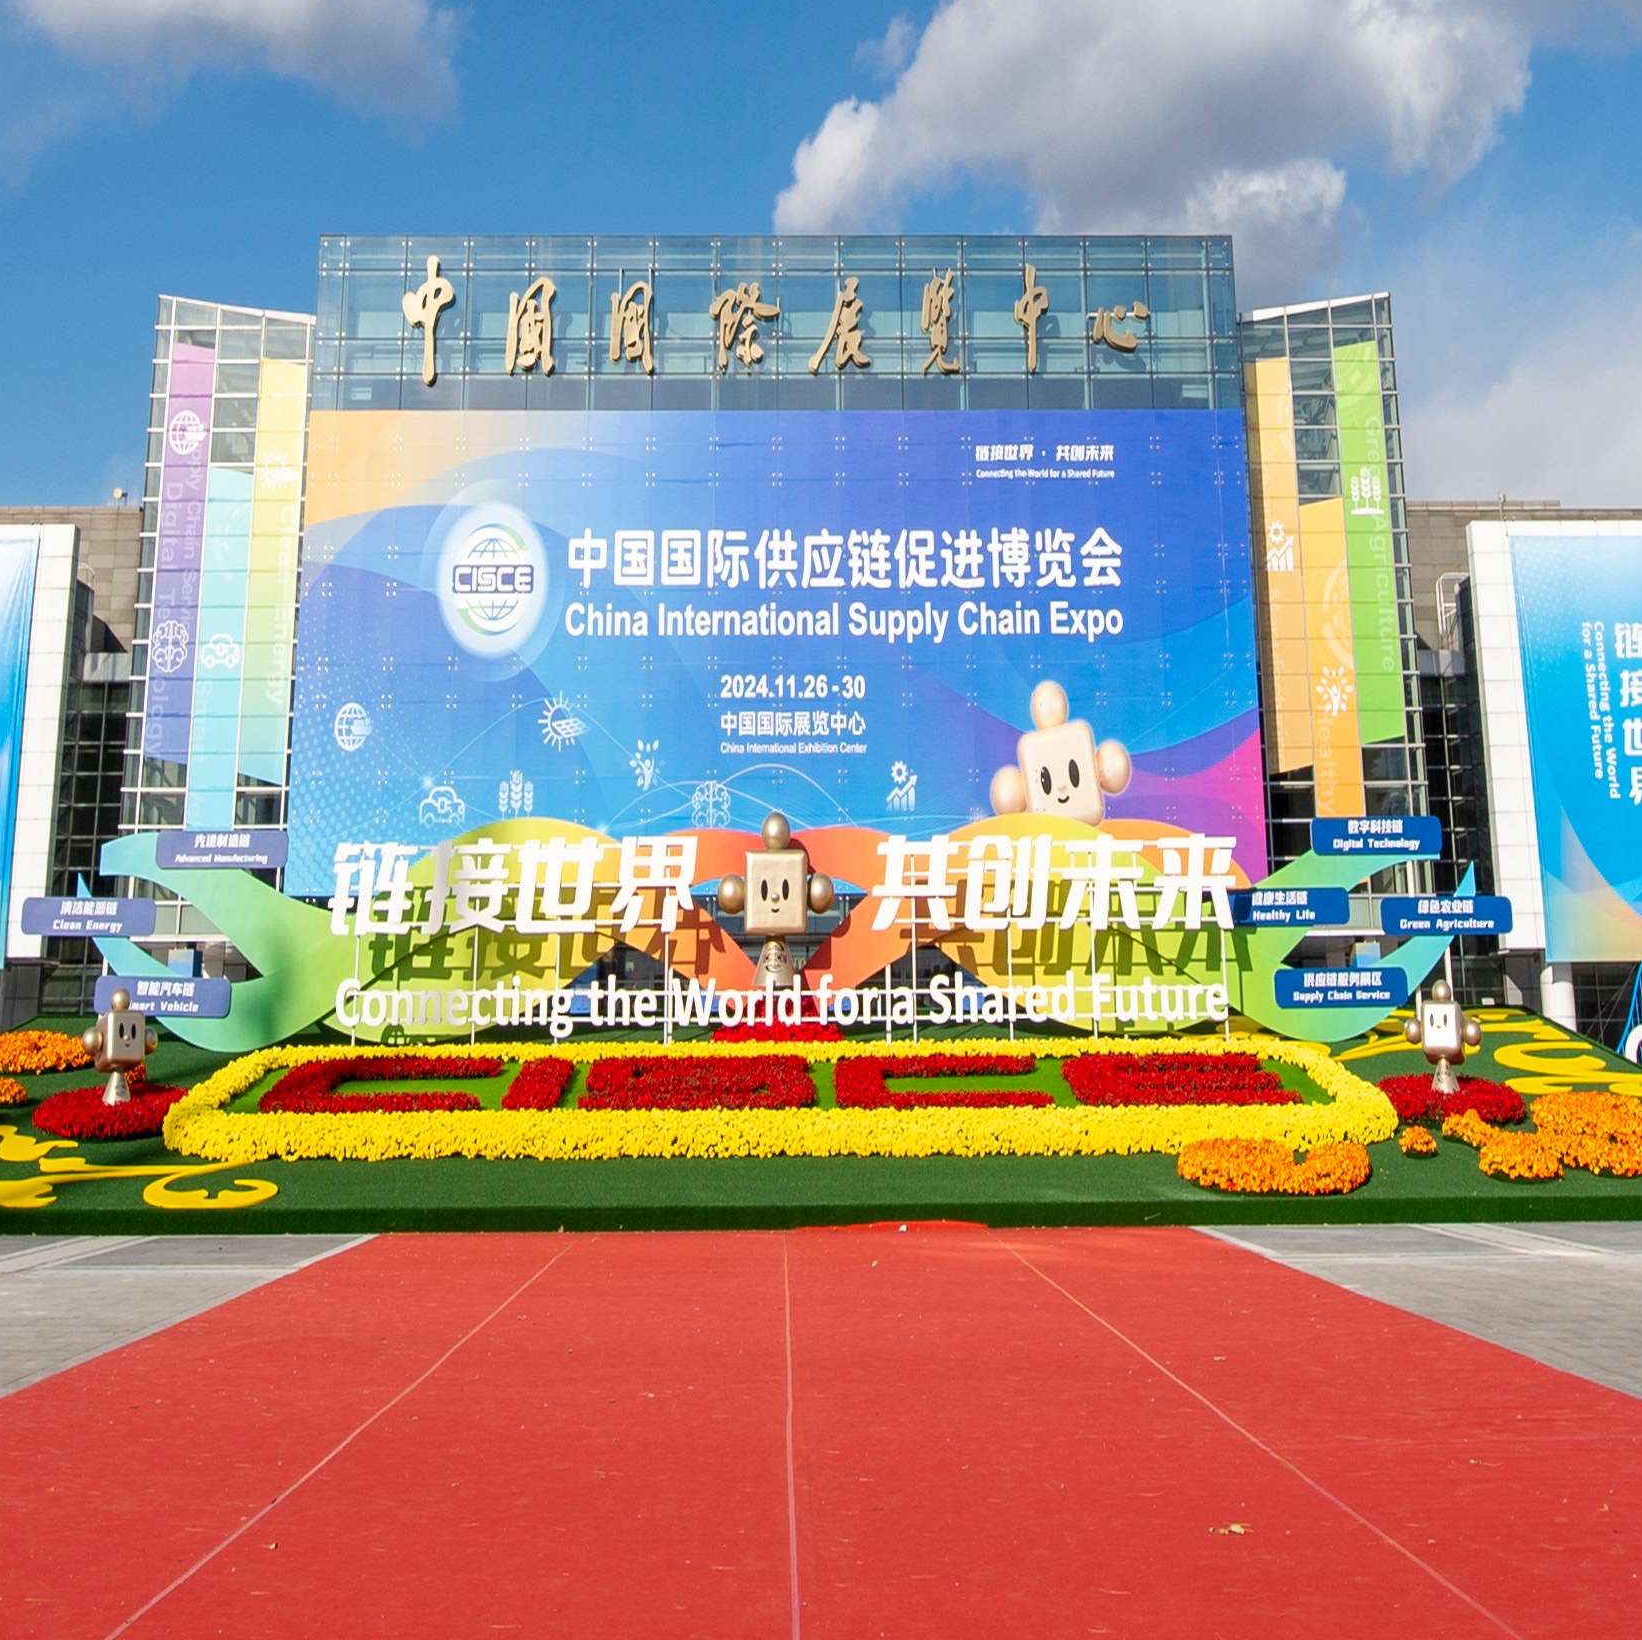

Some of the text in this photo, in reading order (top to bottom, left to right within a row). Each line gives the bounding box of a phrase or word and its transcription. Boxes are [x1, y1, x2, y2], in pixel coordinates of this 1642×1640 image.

[567, 527, 1123, 589] 中国国际供应链促进博览会
[453, 565, 534, 593] CISCE
[565, 601, 1124, 644] China International Supply Chain Expo
[1581, 621, 1604, 780] for a Shared Future
[1594, 621, 1622, 800] Connecting the World
[720, 710, 867, 737] 中国国际展览中心
[720, 742, 867, 754] China International Exhibition Center
[1333, 837, 1421, 851] Digital Technology
[328, 835, 699, 937] 链接世界
[871, 833, 1238, 932] 共创未来
[52, 919, 123, 934] Clean Energy
[1252, 909, 1316, 923] Healthy Life
[1399, 918, 1495, 932] Green Agriculture
[159, 999, 199, 1013] Vehicle
[334, 970, 1230, 1039] Connecting the World for a Shared Future
[1293, 990, 1391, 1003] Supply Chain Service
